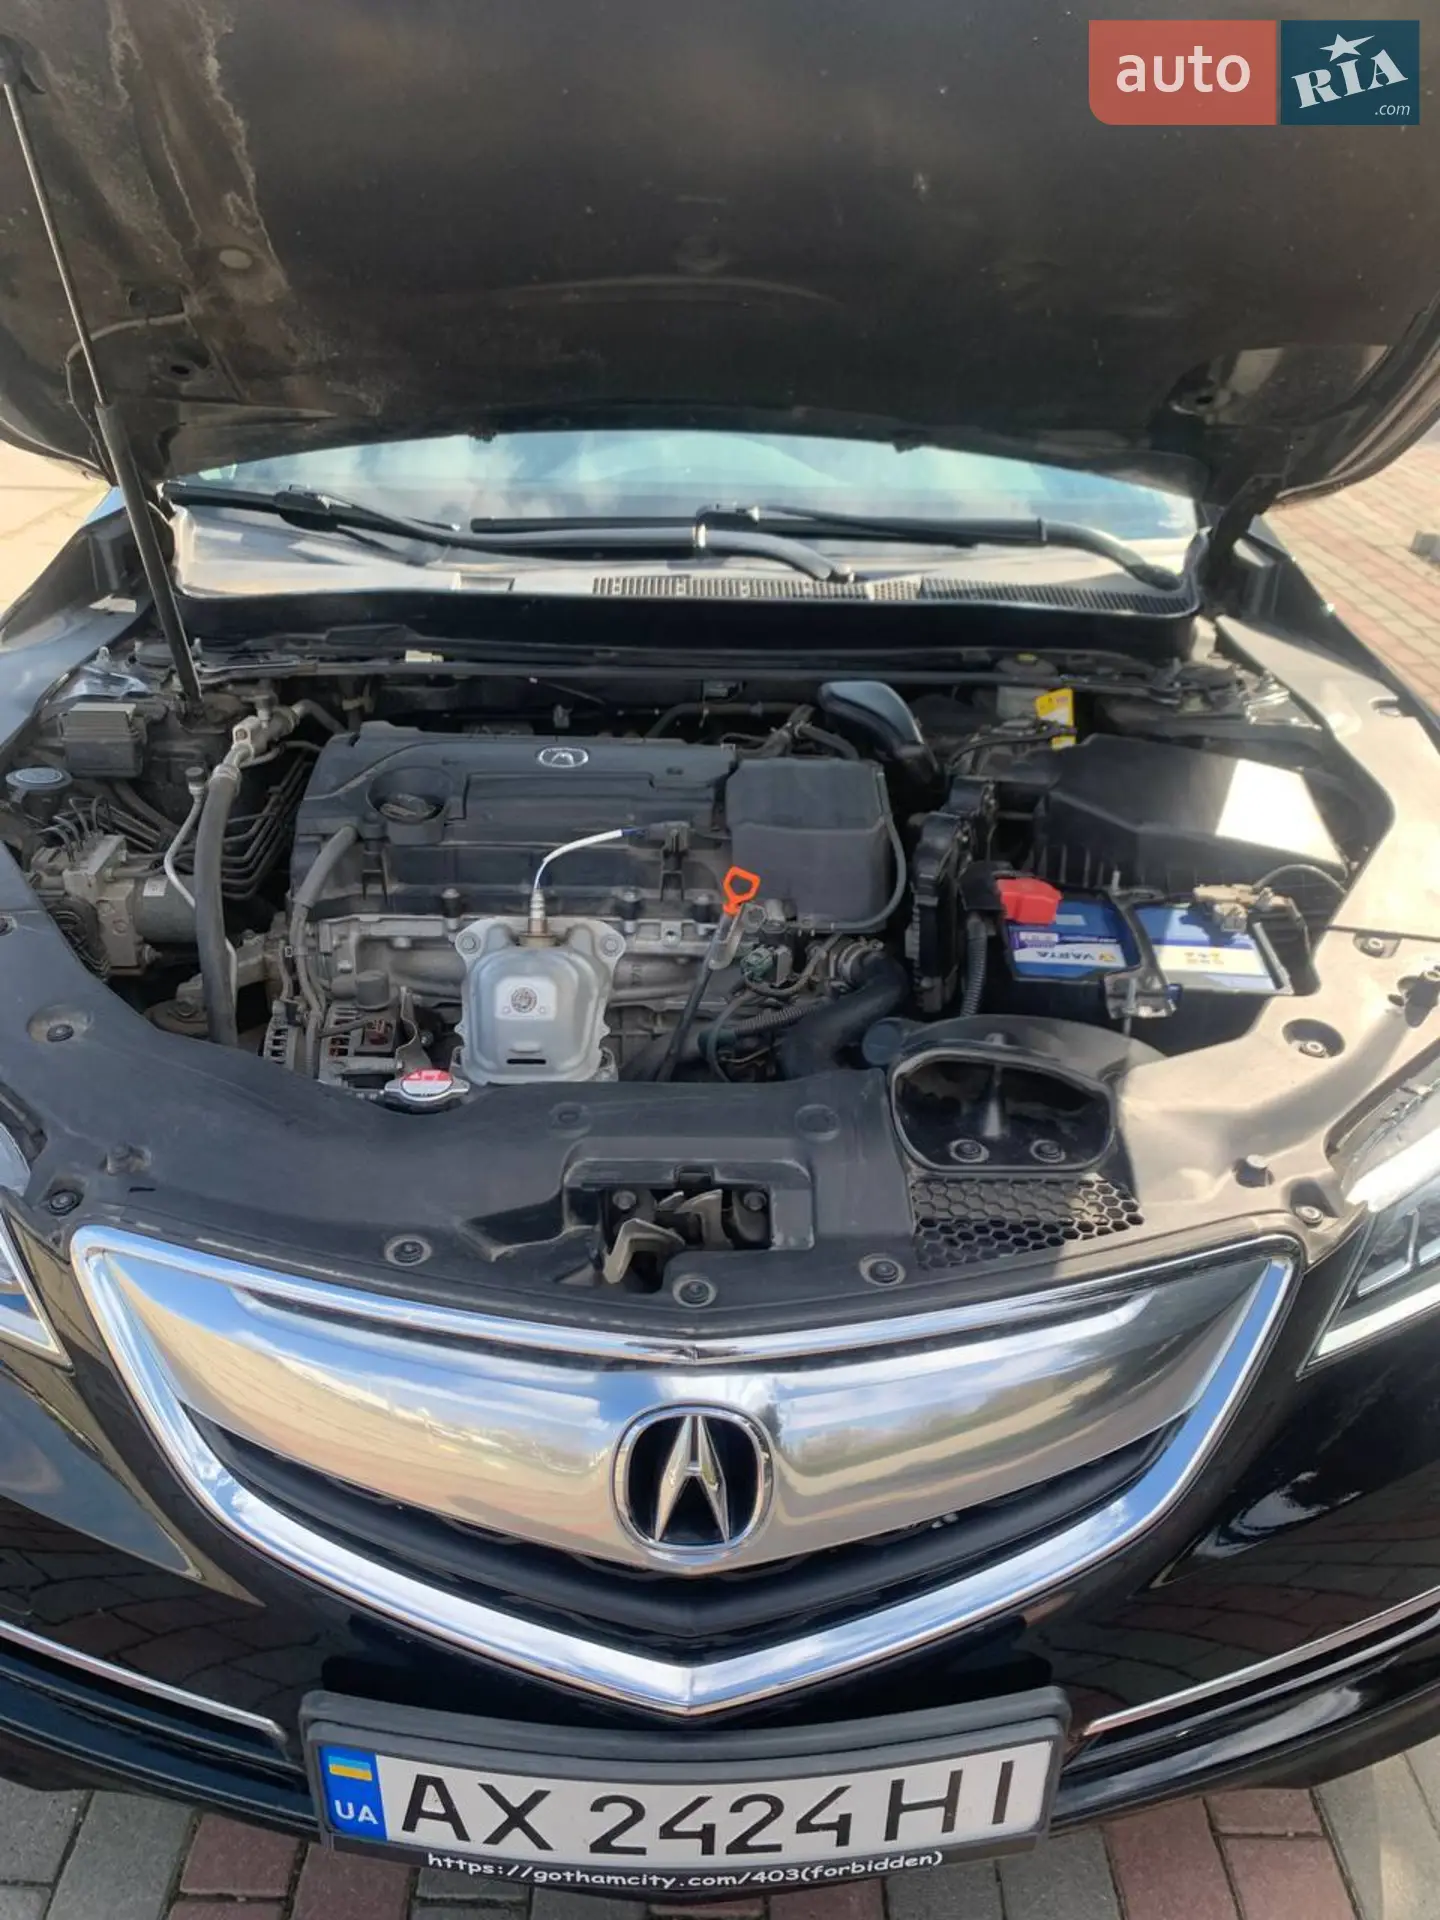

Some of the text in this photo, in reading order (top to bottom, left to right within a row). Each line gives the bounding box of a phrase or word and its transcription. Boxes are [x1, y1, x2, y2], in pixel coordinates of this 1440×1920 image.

[334, 1799, 379, 1825] UA
[402, 1760, 1014, 1856] AX 2424 HI
[428, 1851, 943, 1890] https://gothamcity.com/403(forbidden)
